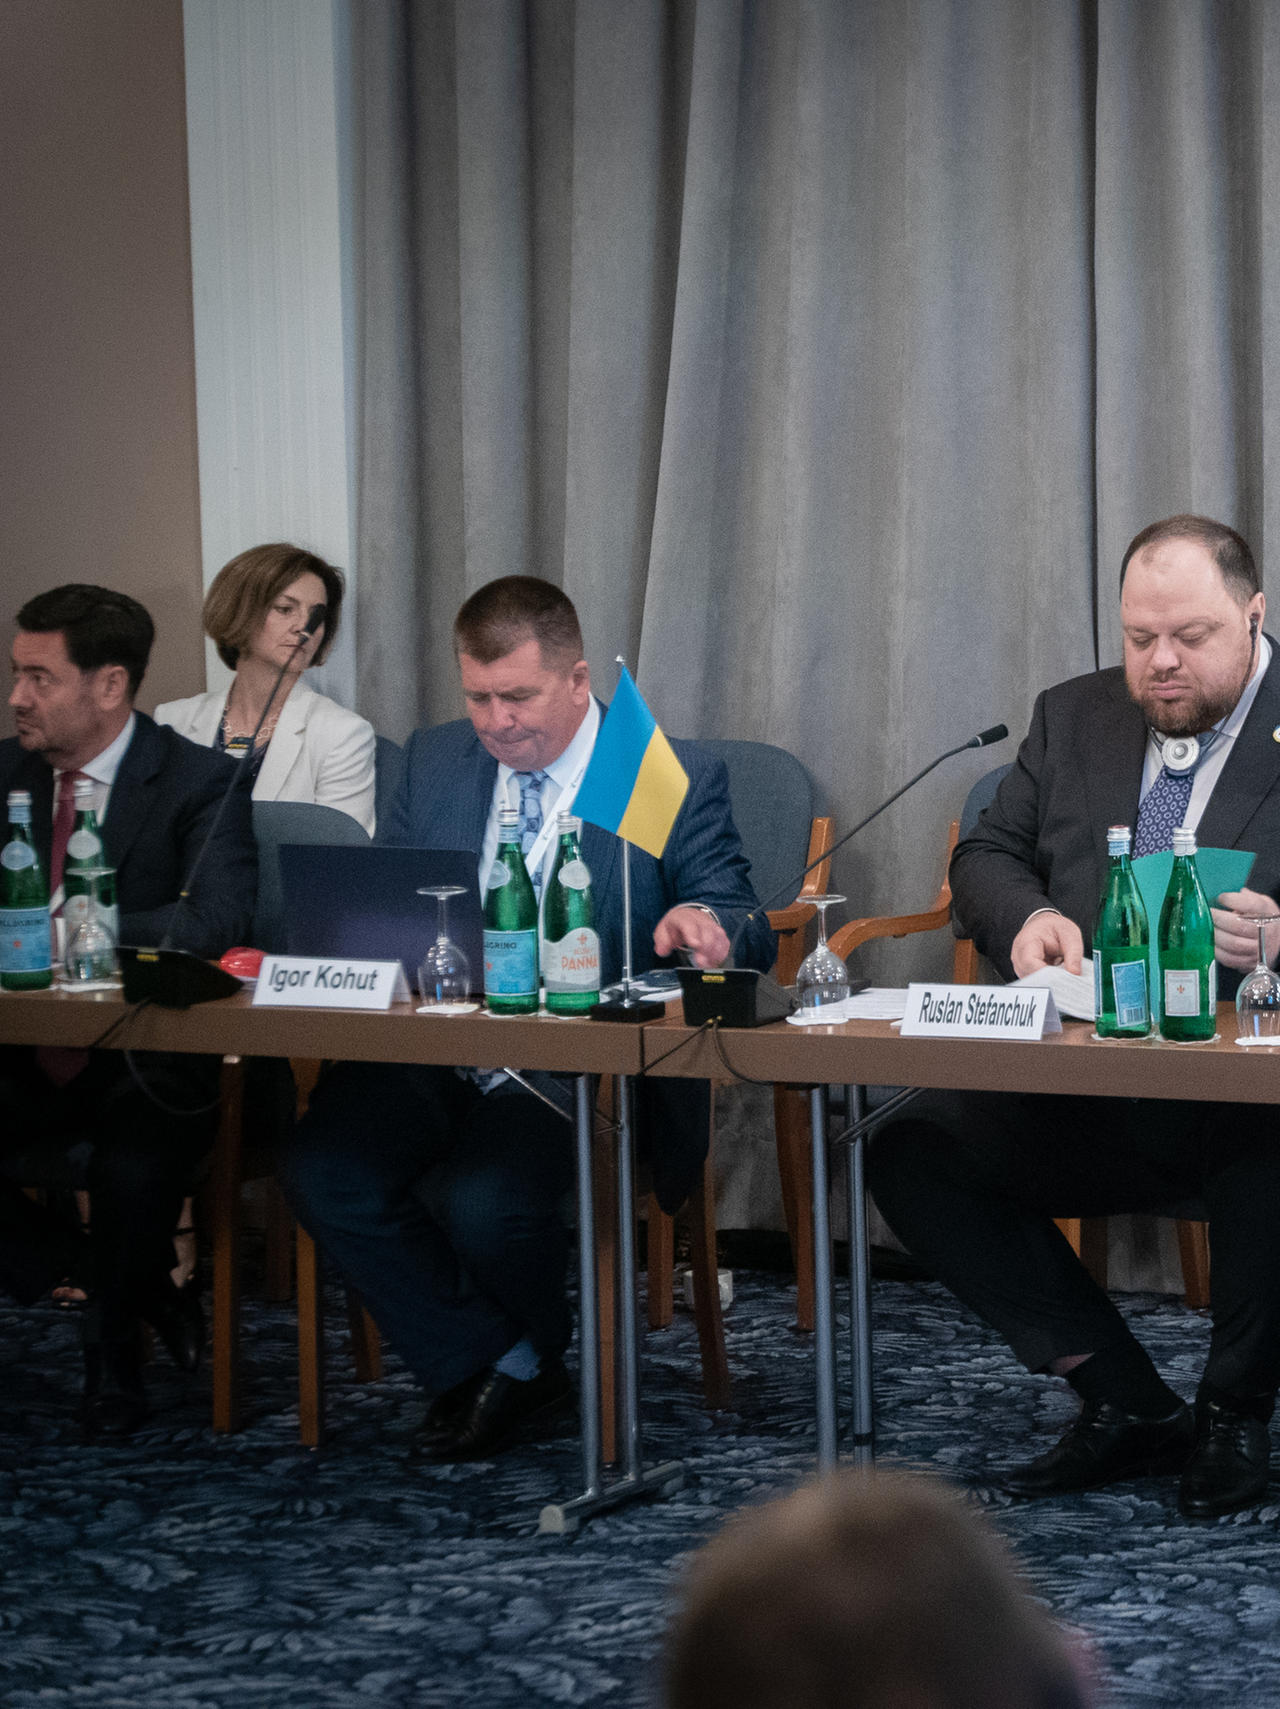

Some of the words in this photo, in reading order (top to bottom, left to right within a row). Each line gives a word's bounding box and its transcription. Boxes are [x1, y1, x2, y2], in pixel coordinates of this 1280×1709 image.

[268, 963, 312, 993] Igor
[314, 964, 378, 991] Kohut
[918, 991, 963, 1024] Ruslan
[965, 992, 1037, 1027] Stefanchuk
